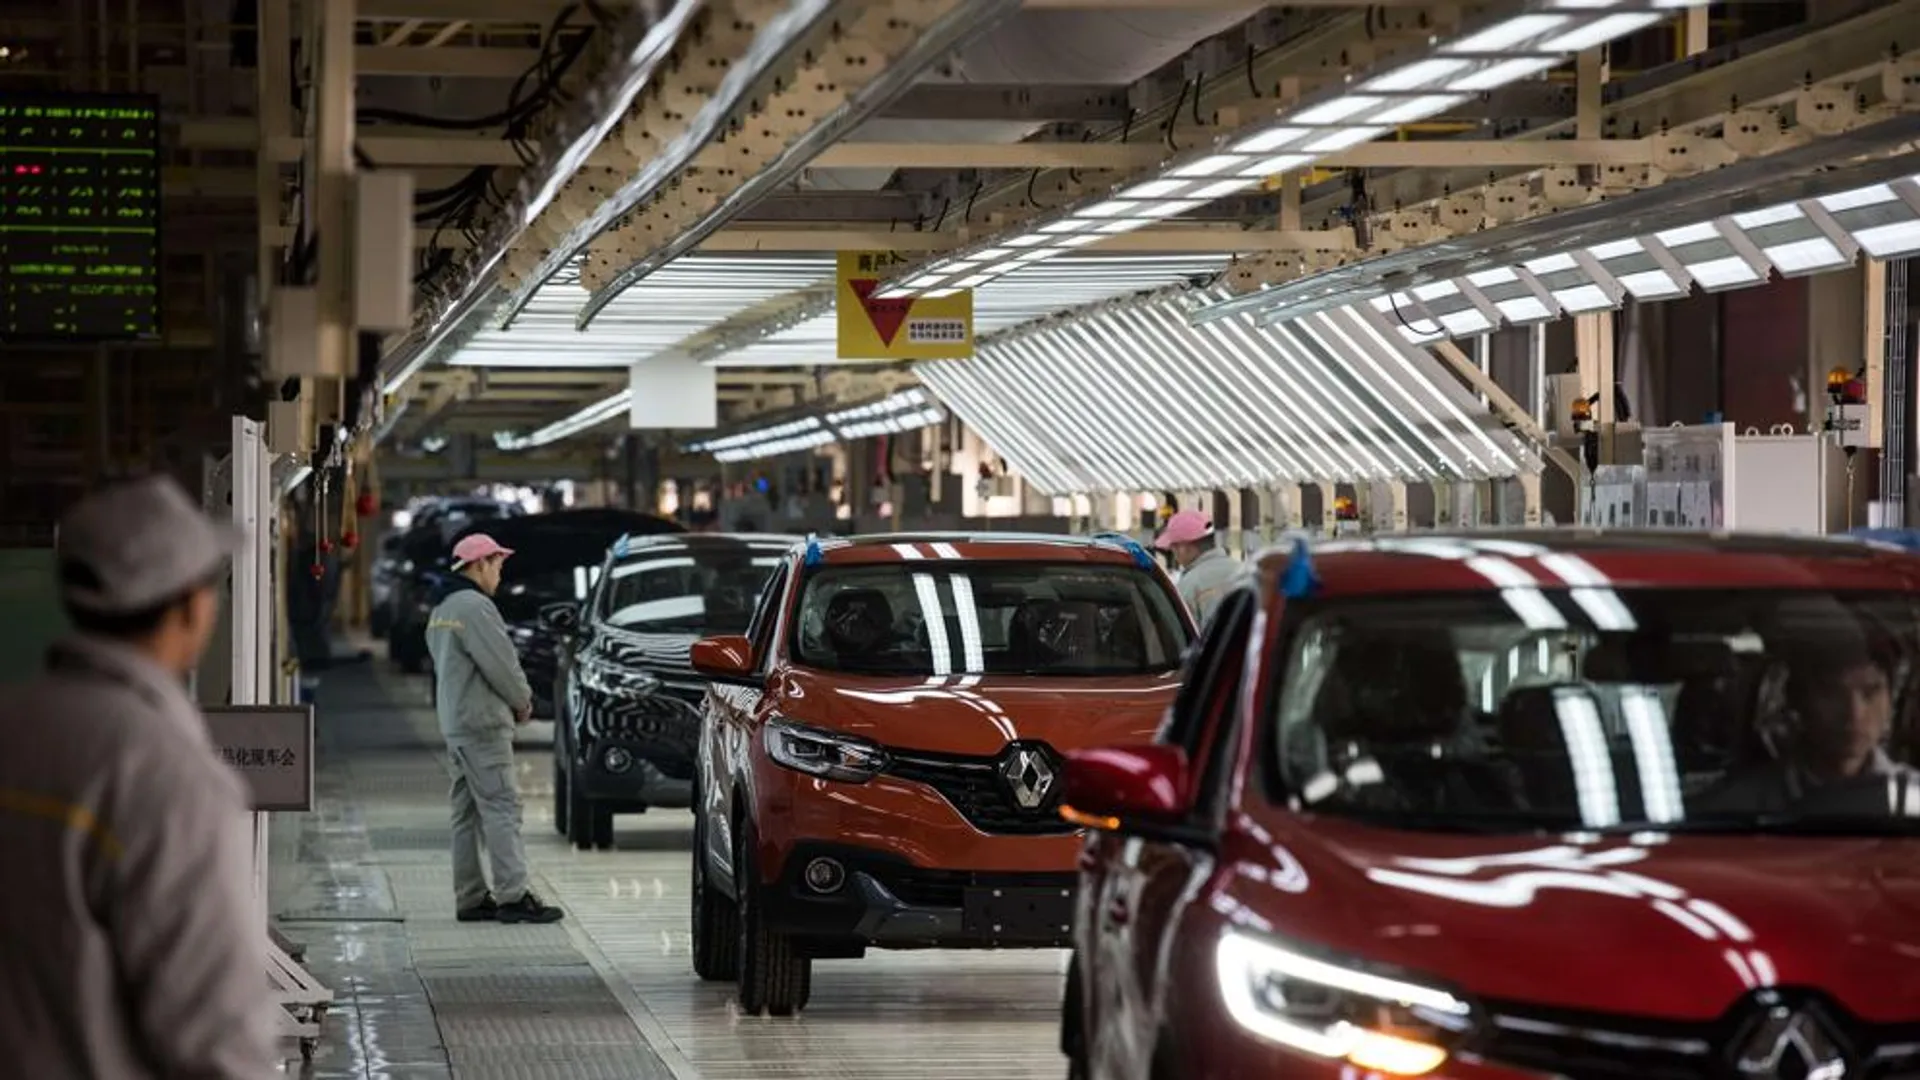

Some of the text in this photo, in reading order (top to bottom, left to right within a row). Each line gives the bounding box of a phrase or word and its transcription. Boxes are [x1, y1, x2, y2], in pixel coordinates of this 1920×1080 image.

[217, 746, 296, 767] 品化现车会
